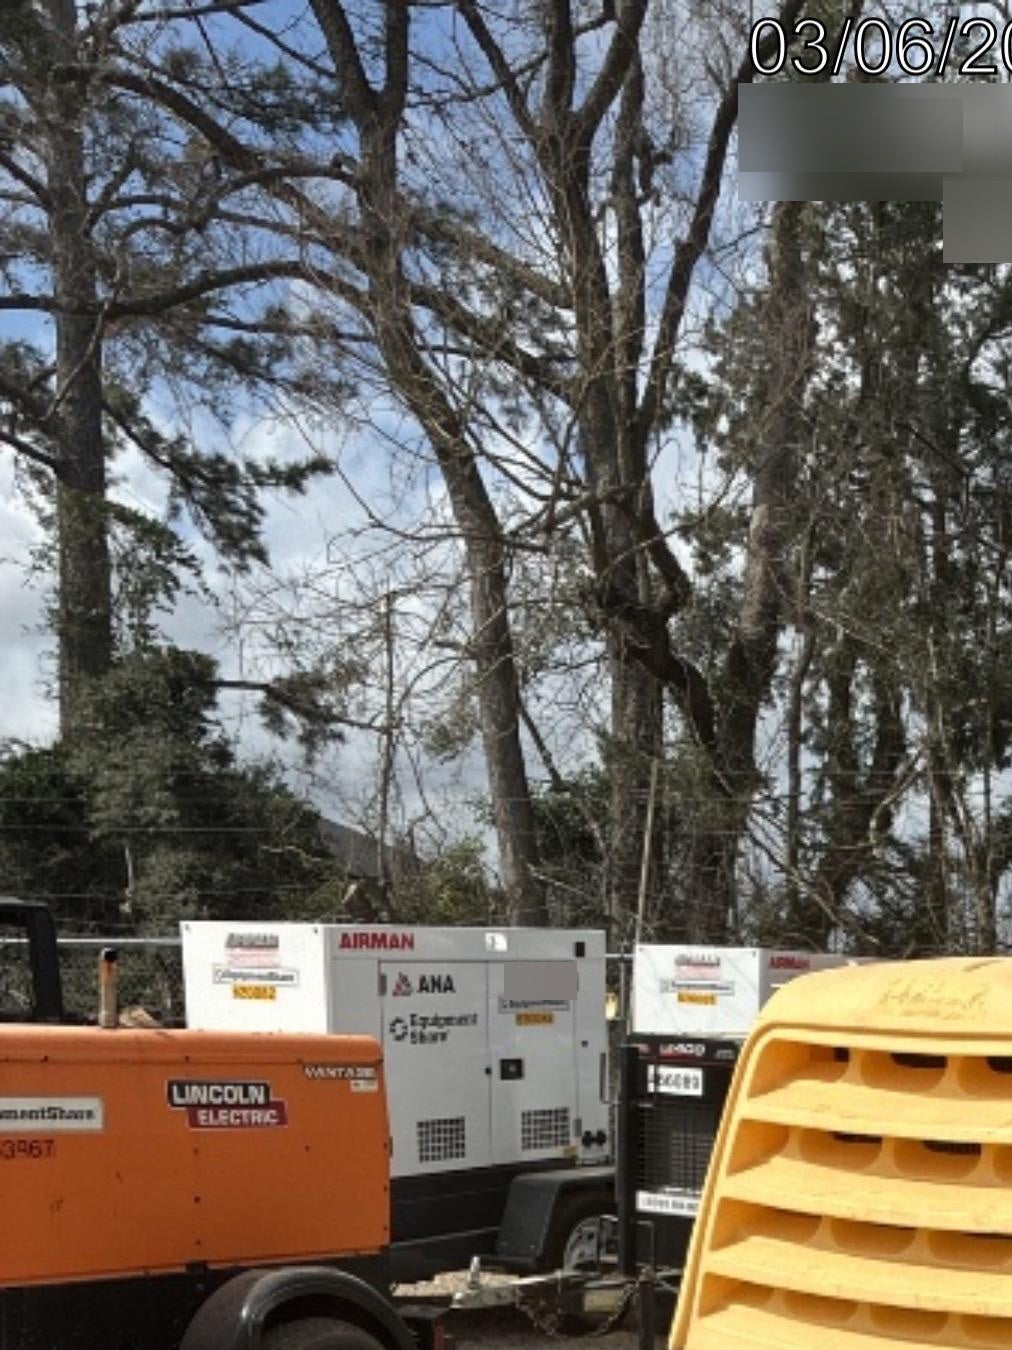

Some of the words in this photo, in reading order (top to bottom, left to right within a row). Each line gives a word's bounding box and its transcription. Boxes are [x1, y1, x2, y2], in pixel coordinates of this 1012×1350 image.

[338, 932, 415, 949] AIRMAN
[417, 974, 456, 994] ANA
[410, 1013, 478, 1030] Equipment
[410, 1030, 450, 1045] Share
[171, 1084, 267, 1104] LINCOLN
[0, 1106, 96, 1121] mentShare
[197, 1109, 280, 1125] ELECTRIC
[0, 1139, 55, 1159] 3967
